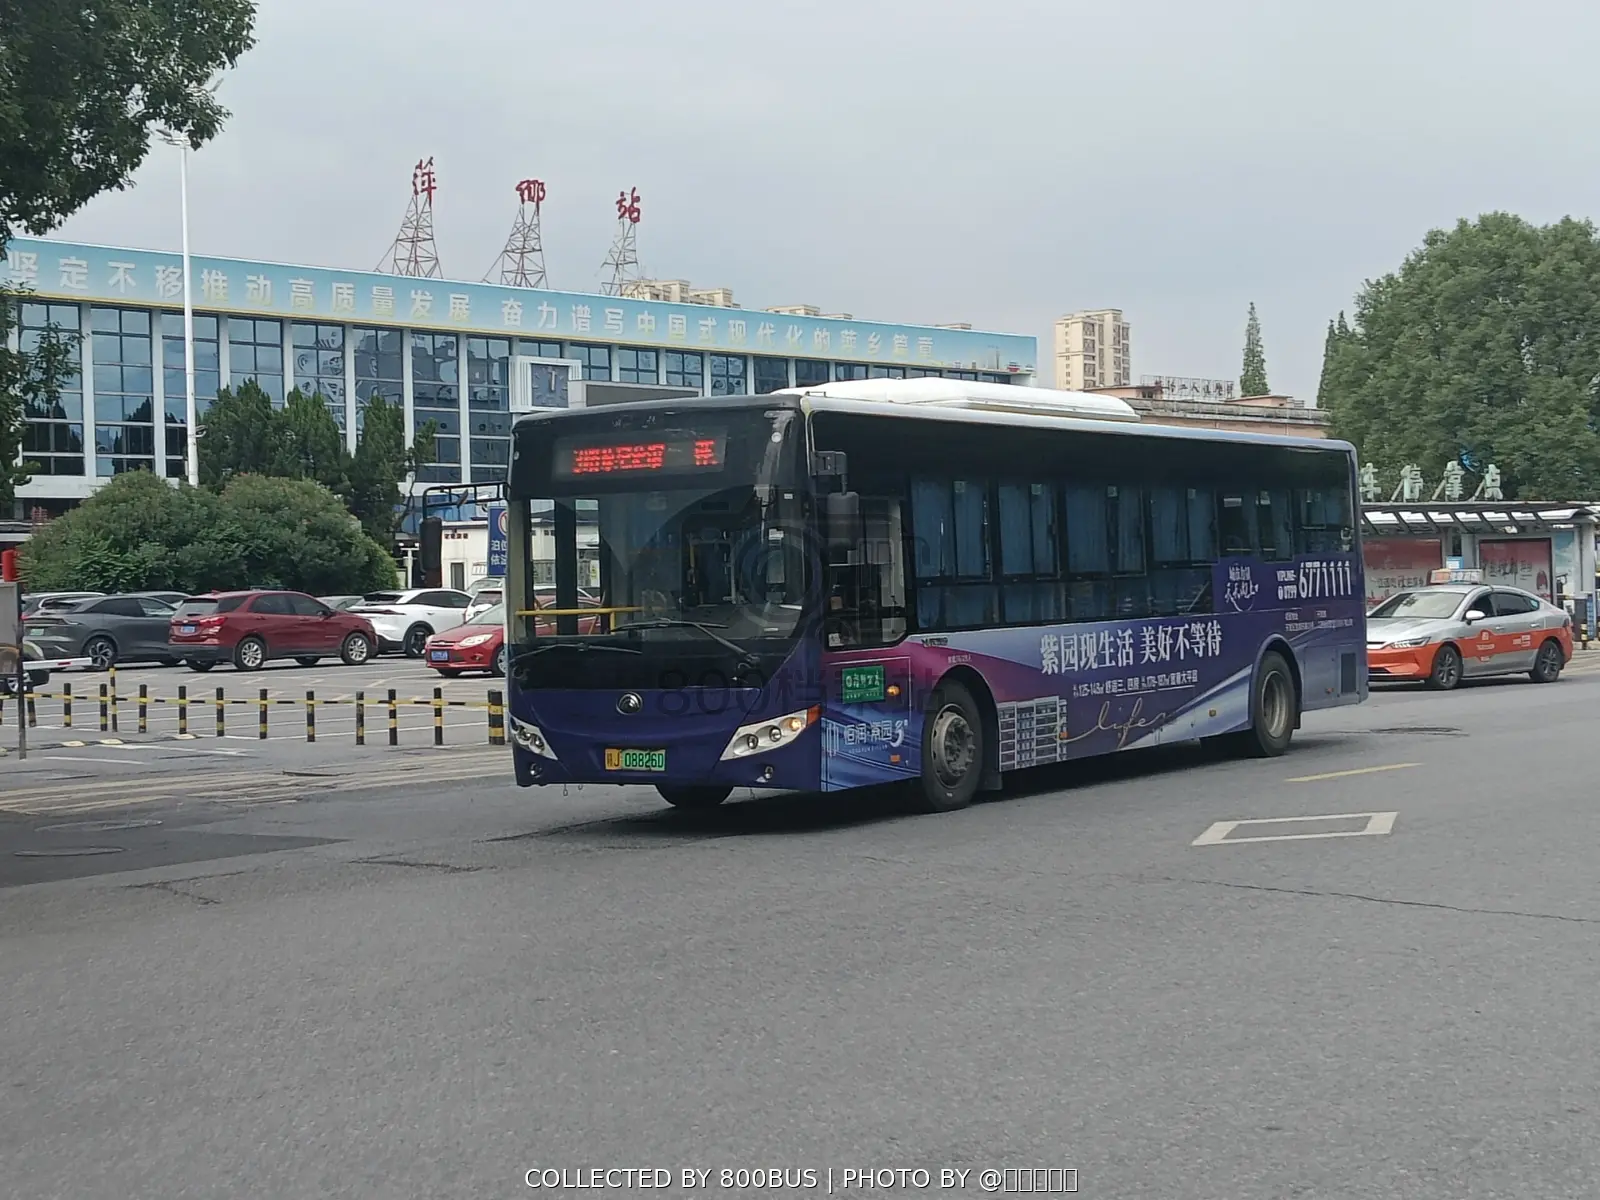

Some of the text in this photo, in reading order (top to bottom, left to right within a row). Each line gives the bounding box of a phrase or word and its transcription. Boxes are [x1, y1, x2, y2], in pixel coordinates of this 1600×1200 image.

[8, 251, 473, 323] 坚定不移推动高质量发展
[1299, 561, 1352, 598] 6771111
[1040, 620, 1223, 675] 紫园现生活 美好不等待
